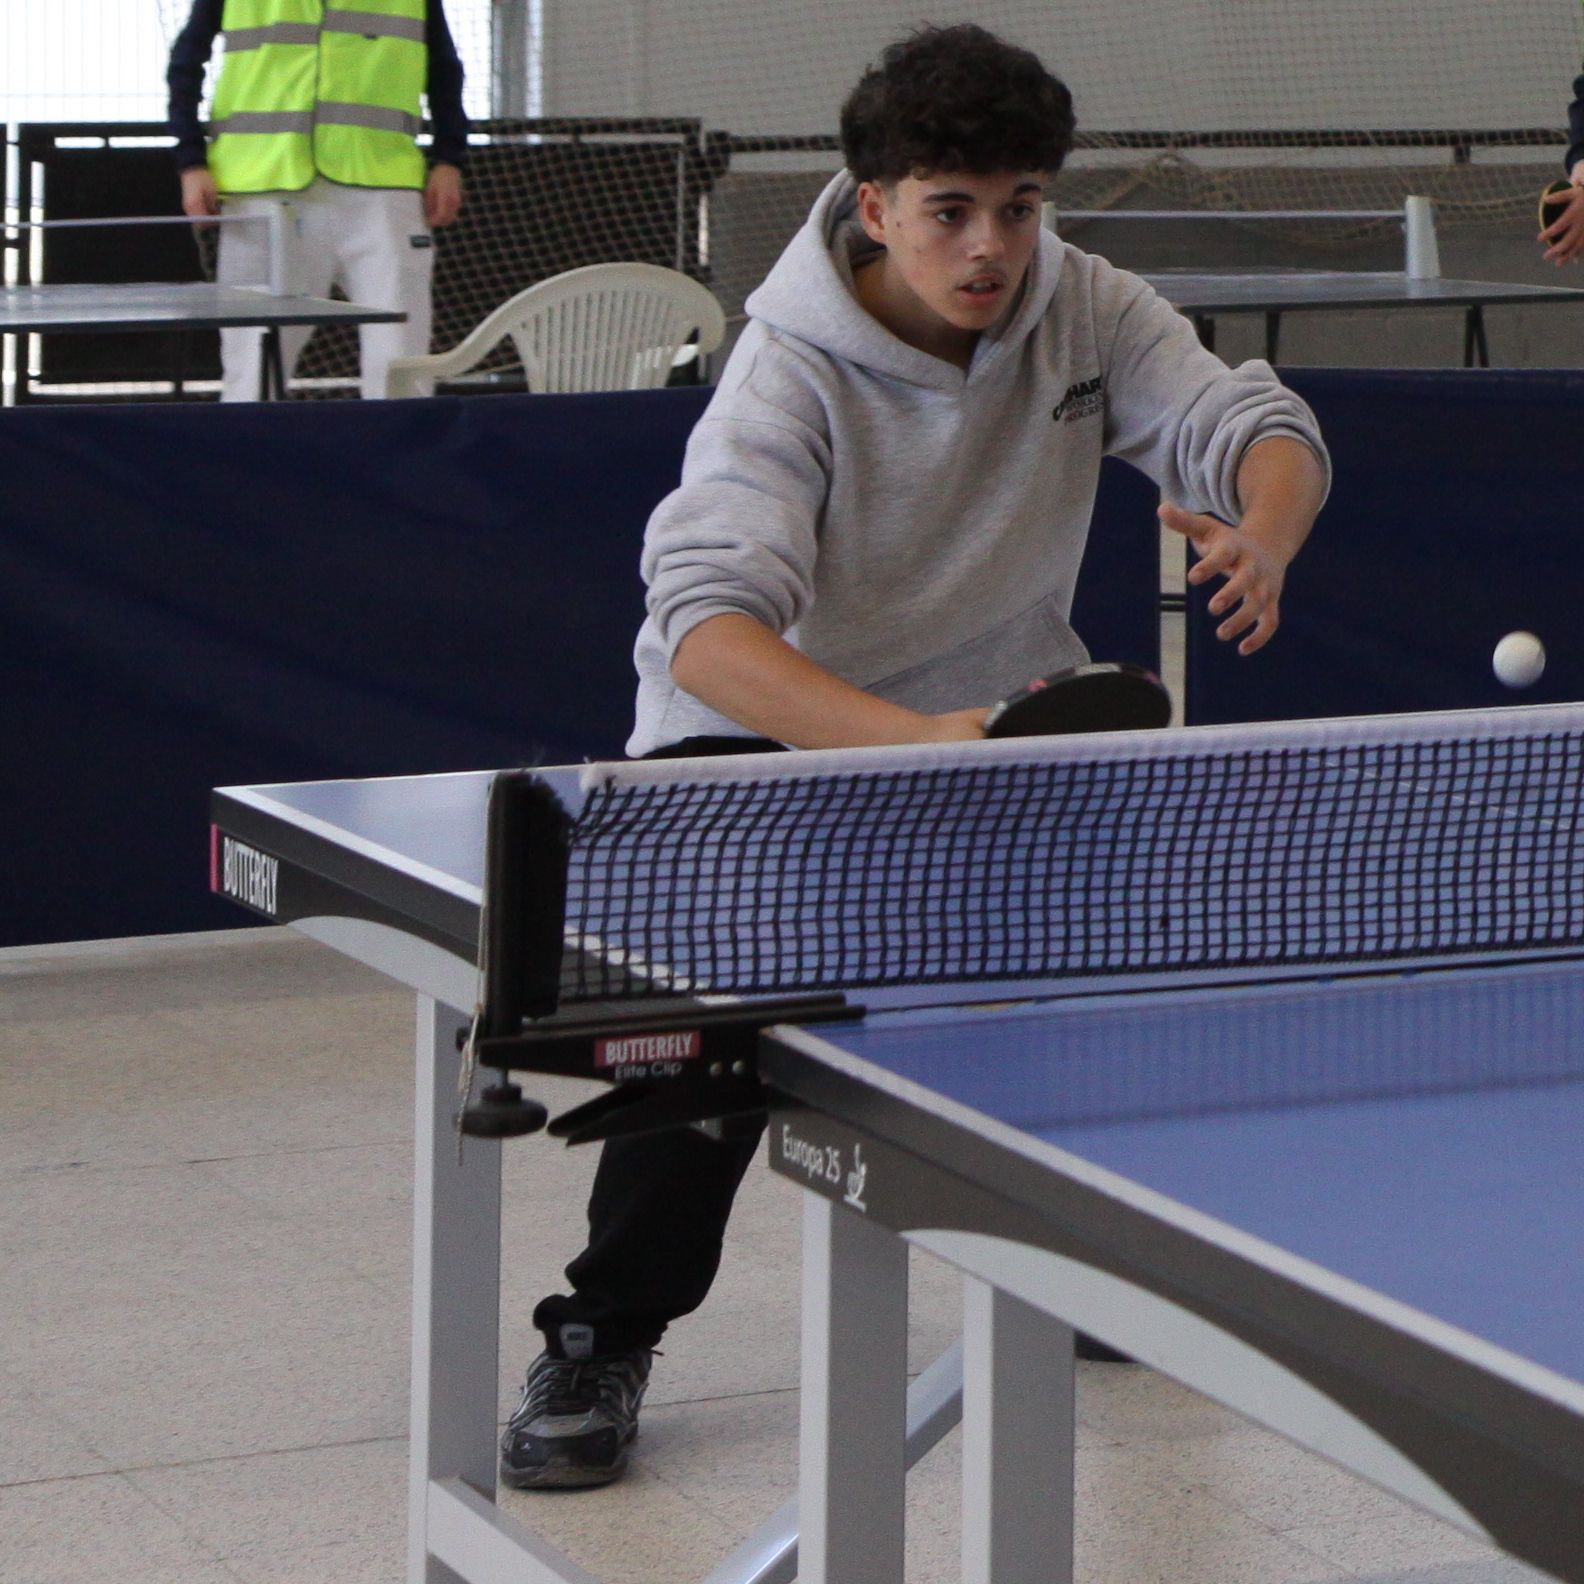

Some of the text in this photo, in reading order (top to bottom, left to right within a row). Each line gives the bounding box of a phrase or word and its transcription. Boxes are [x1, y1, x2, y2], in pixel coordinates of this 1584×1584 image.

[223, 836, 279, 916] BUTTERFLY
[605, 1033, 693, 1065] BUTTERFLY
[782, 1123, 841, 1184] Europa 25
